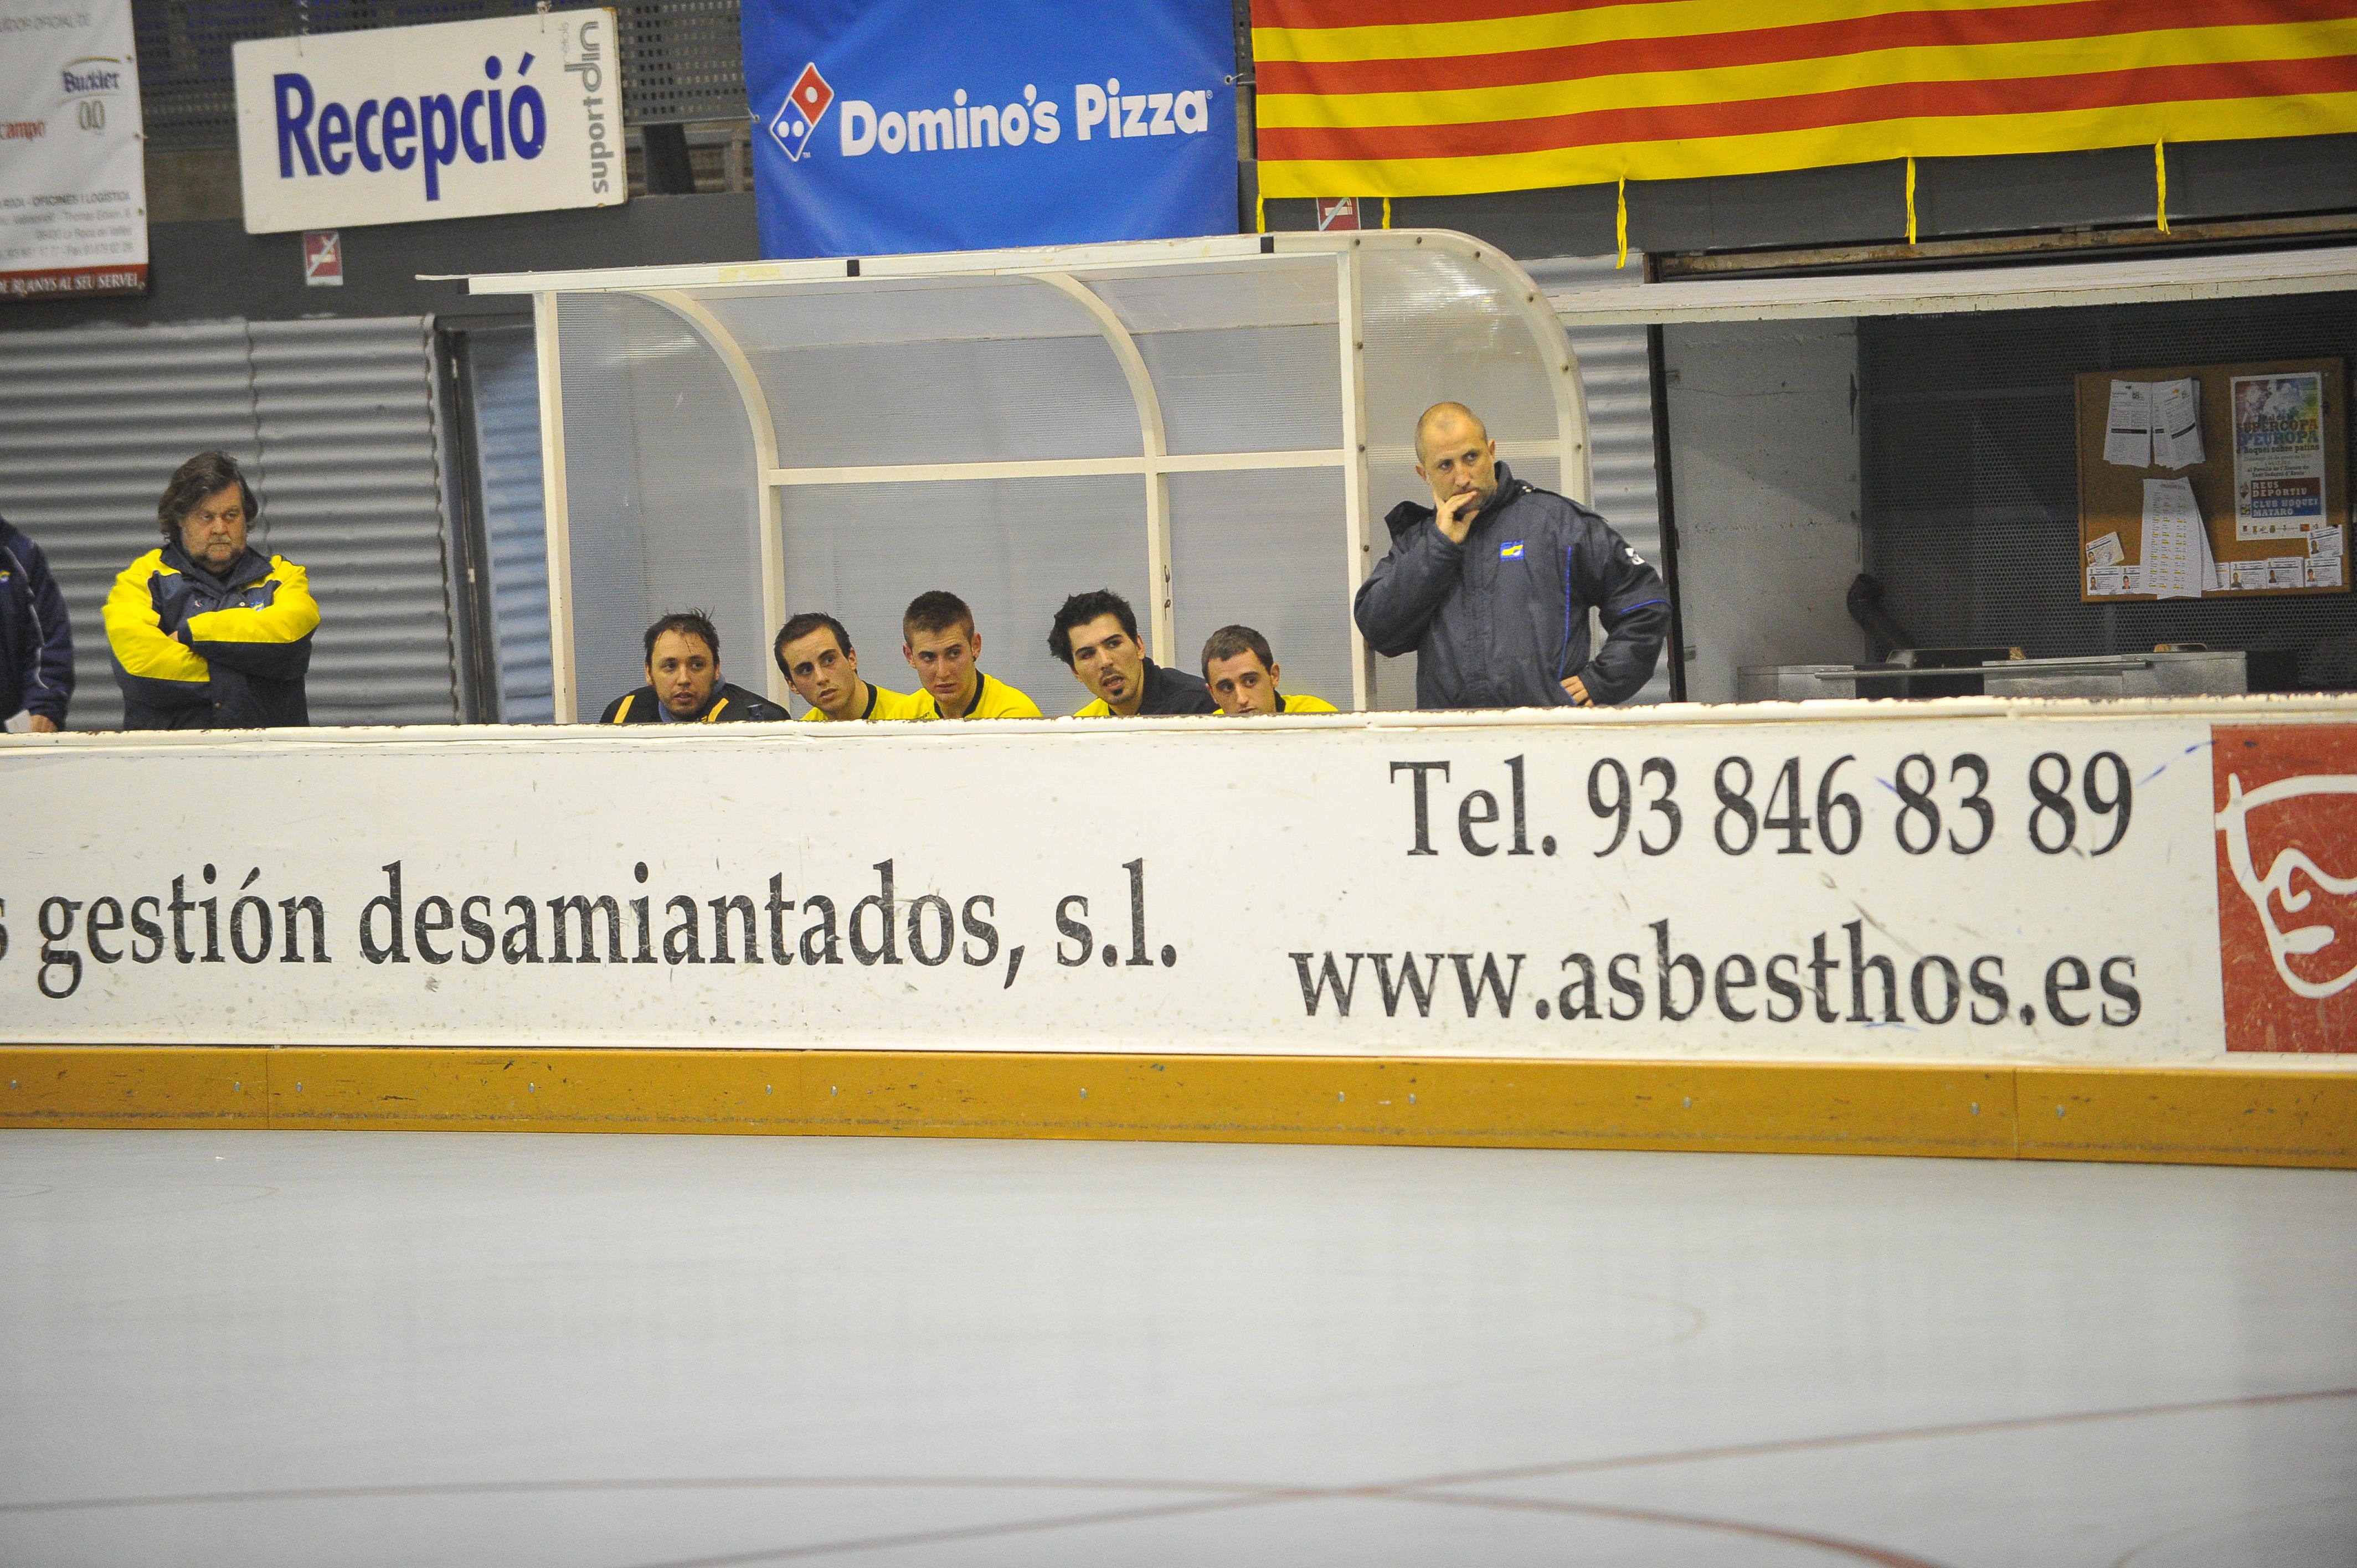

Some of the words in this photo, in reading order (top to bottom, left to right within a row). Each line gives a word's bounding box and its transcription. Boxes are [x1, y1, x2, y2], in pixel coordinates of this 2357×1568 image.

[61, 69, 120, 93] Buckler
[274, 52, 547, 202] Recepció
[840, 88, 1062, 158] Domino's
[2236, 419, 2318, 434] SUPERCOPA
[2271, 445, 2292, 453] sobre
[2294, 443, 2319, 453] patins
[2252, 481, 2279, 489] REUS
[2252, 488, 2307, 498] DEPORTIU
[2253, 500, 2278, 508] CLUB
[2282, 498, 2318, 508] HOQUEI
[1390, 755, 1555, 856] Tel.
[1588, 757, 1681, 857] 93
[1715, 755, 1861, 855] 846
[1896, 754, 1993, 854] 83
[2029, 752, 2132, 856] 89
[38, 864, 331, 999] gestión
[360, 859, 1024, 989] desamiantados,
[1056, 858, 1176, 967] s.l.
[1289, 919, 2140, 1027] www.asbesthos.es
